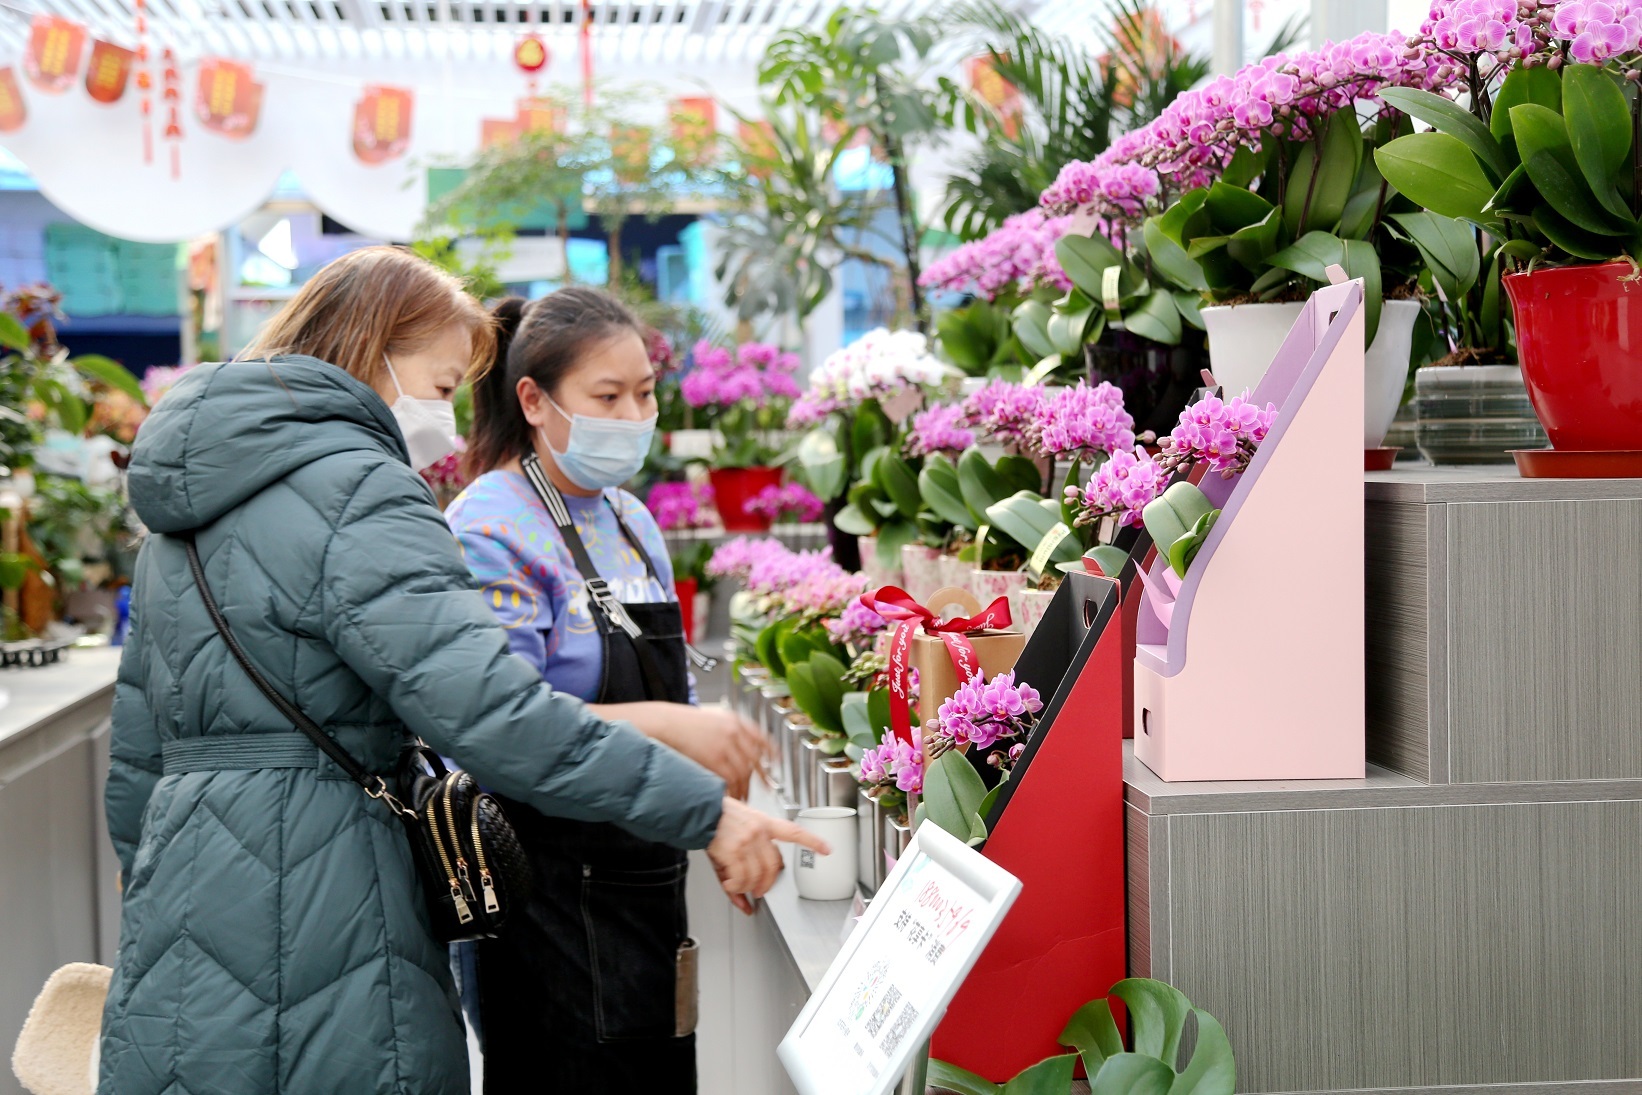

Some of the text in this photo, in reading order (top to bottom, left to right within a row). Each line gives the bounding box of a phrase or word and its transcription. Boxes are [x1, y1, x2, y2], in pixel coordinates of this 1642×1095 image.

[891, 623, 910, 699] Just for you
[951, 641, 971, 662] for
